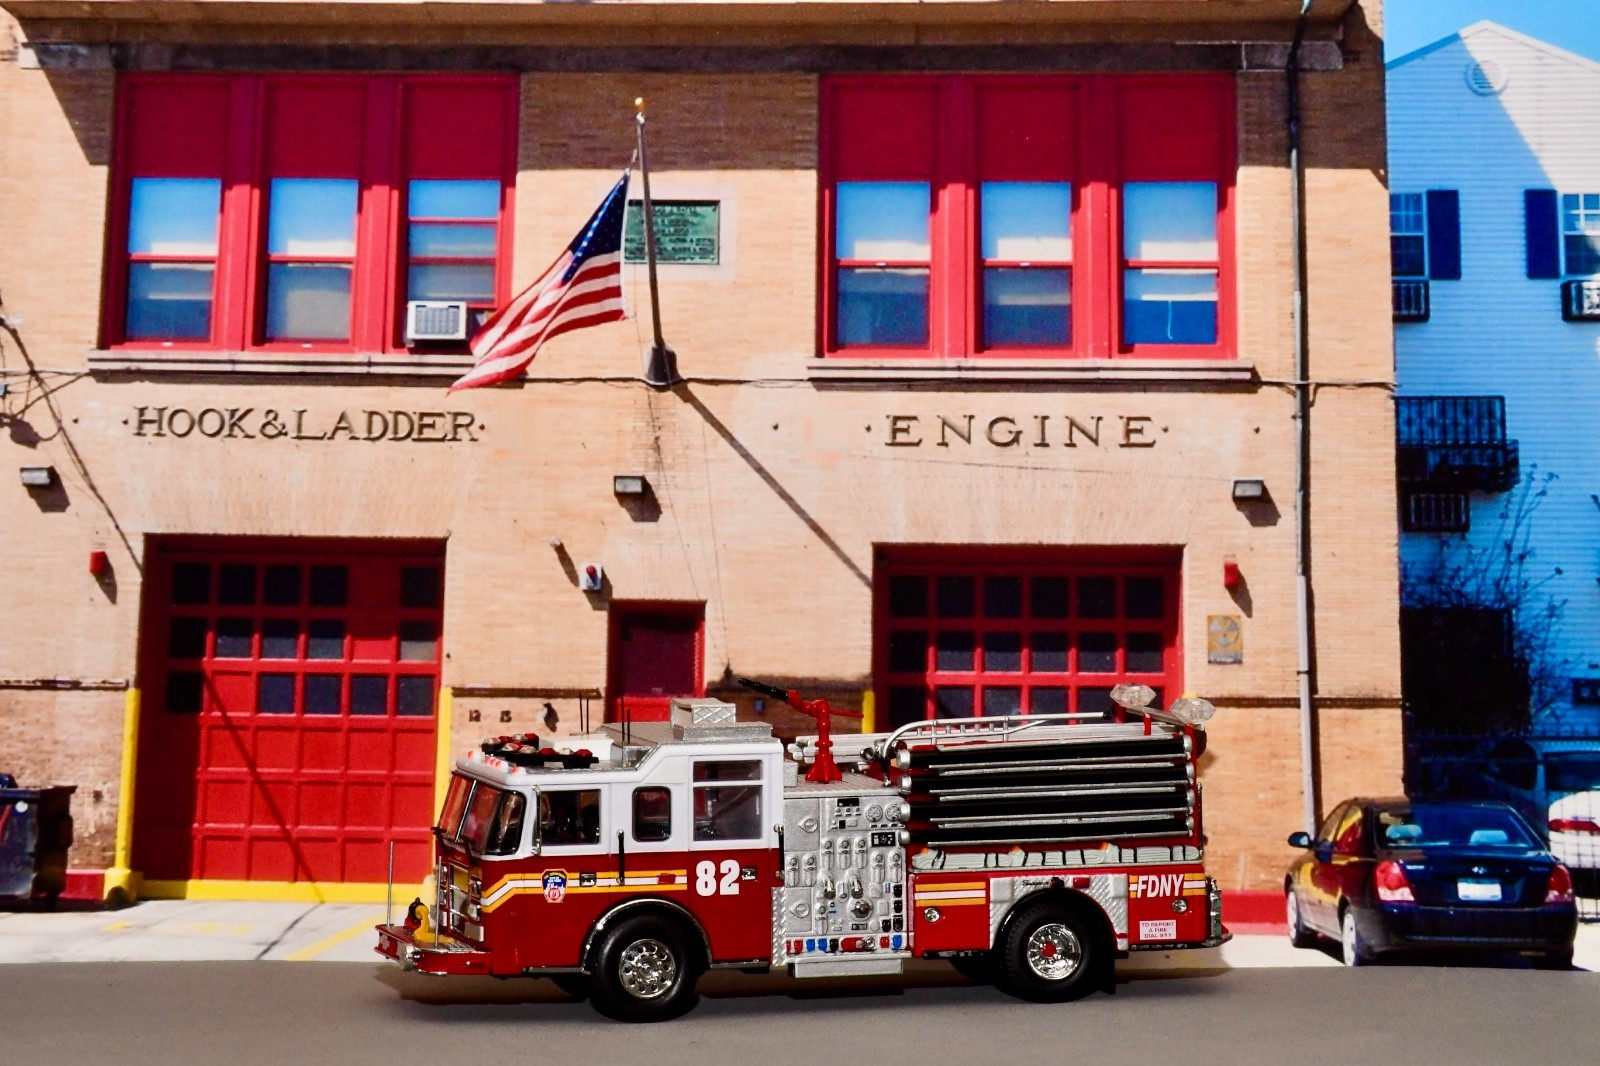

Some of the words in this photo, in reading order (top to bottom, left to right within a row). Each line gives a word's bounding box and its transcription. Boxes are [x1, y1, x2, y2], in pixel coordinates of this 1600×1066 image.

[885, 415, 1157, 448] ENGINE
[695, 859, 740, 896] 82
[1136, 873, 1185, 898] FDNY
